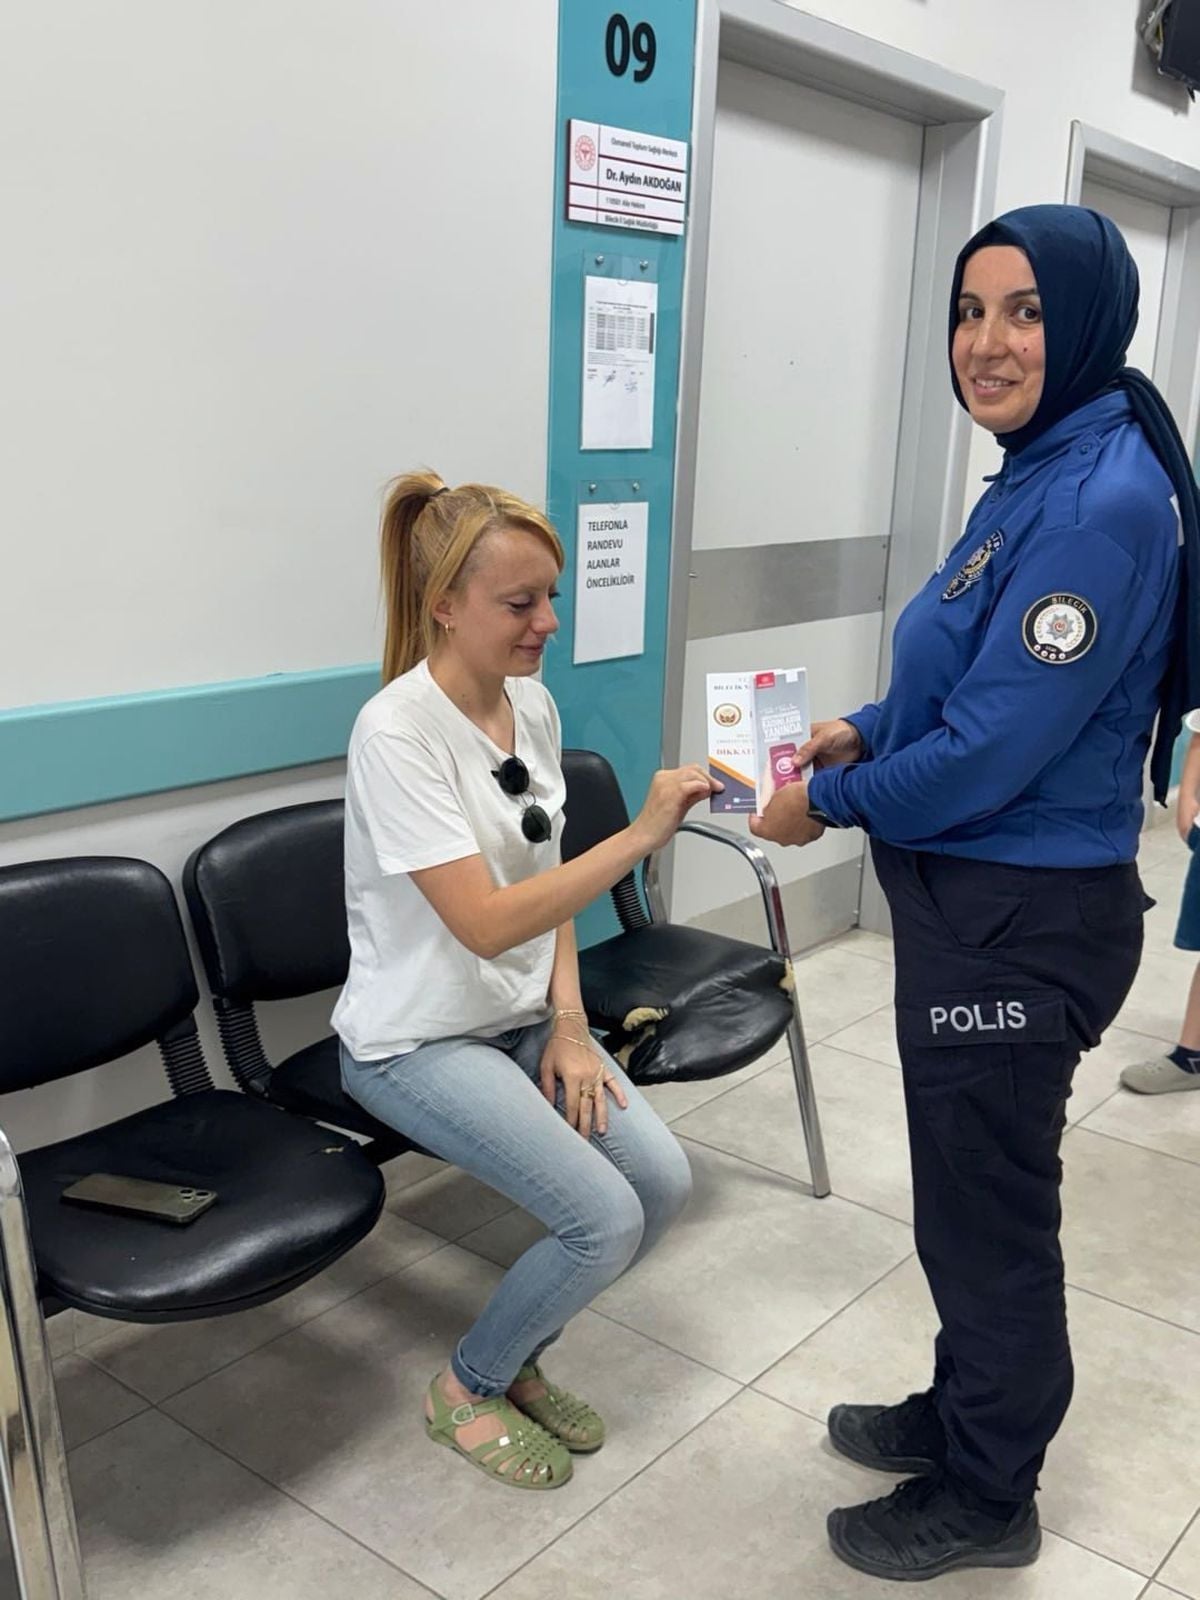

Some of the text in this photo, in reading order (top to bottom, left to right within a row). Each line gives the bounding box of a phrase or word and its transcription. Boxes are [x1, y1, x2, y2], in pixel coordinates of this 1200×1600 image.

[605, 13, 656, 83] 09
[606, 168, 682, 193] Dr. Aydın AKDOĞAN
[588, 519, 628, 532] TELEFONLA
[587, 538, 623, 552] RANDEVU
[586, 557, 620, 571] ALANLAR
[586, 573, 635, 589] ÖNCELİKLİDİR
